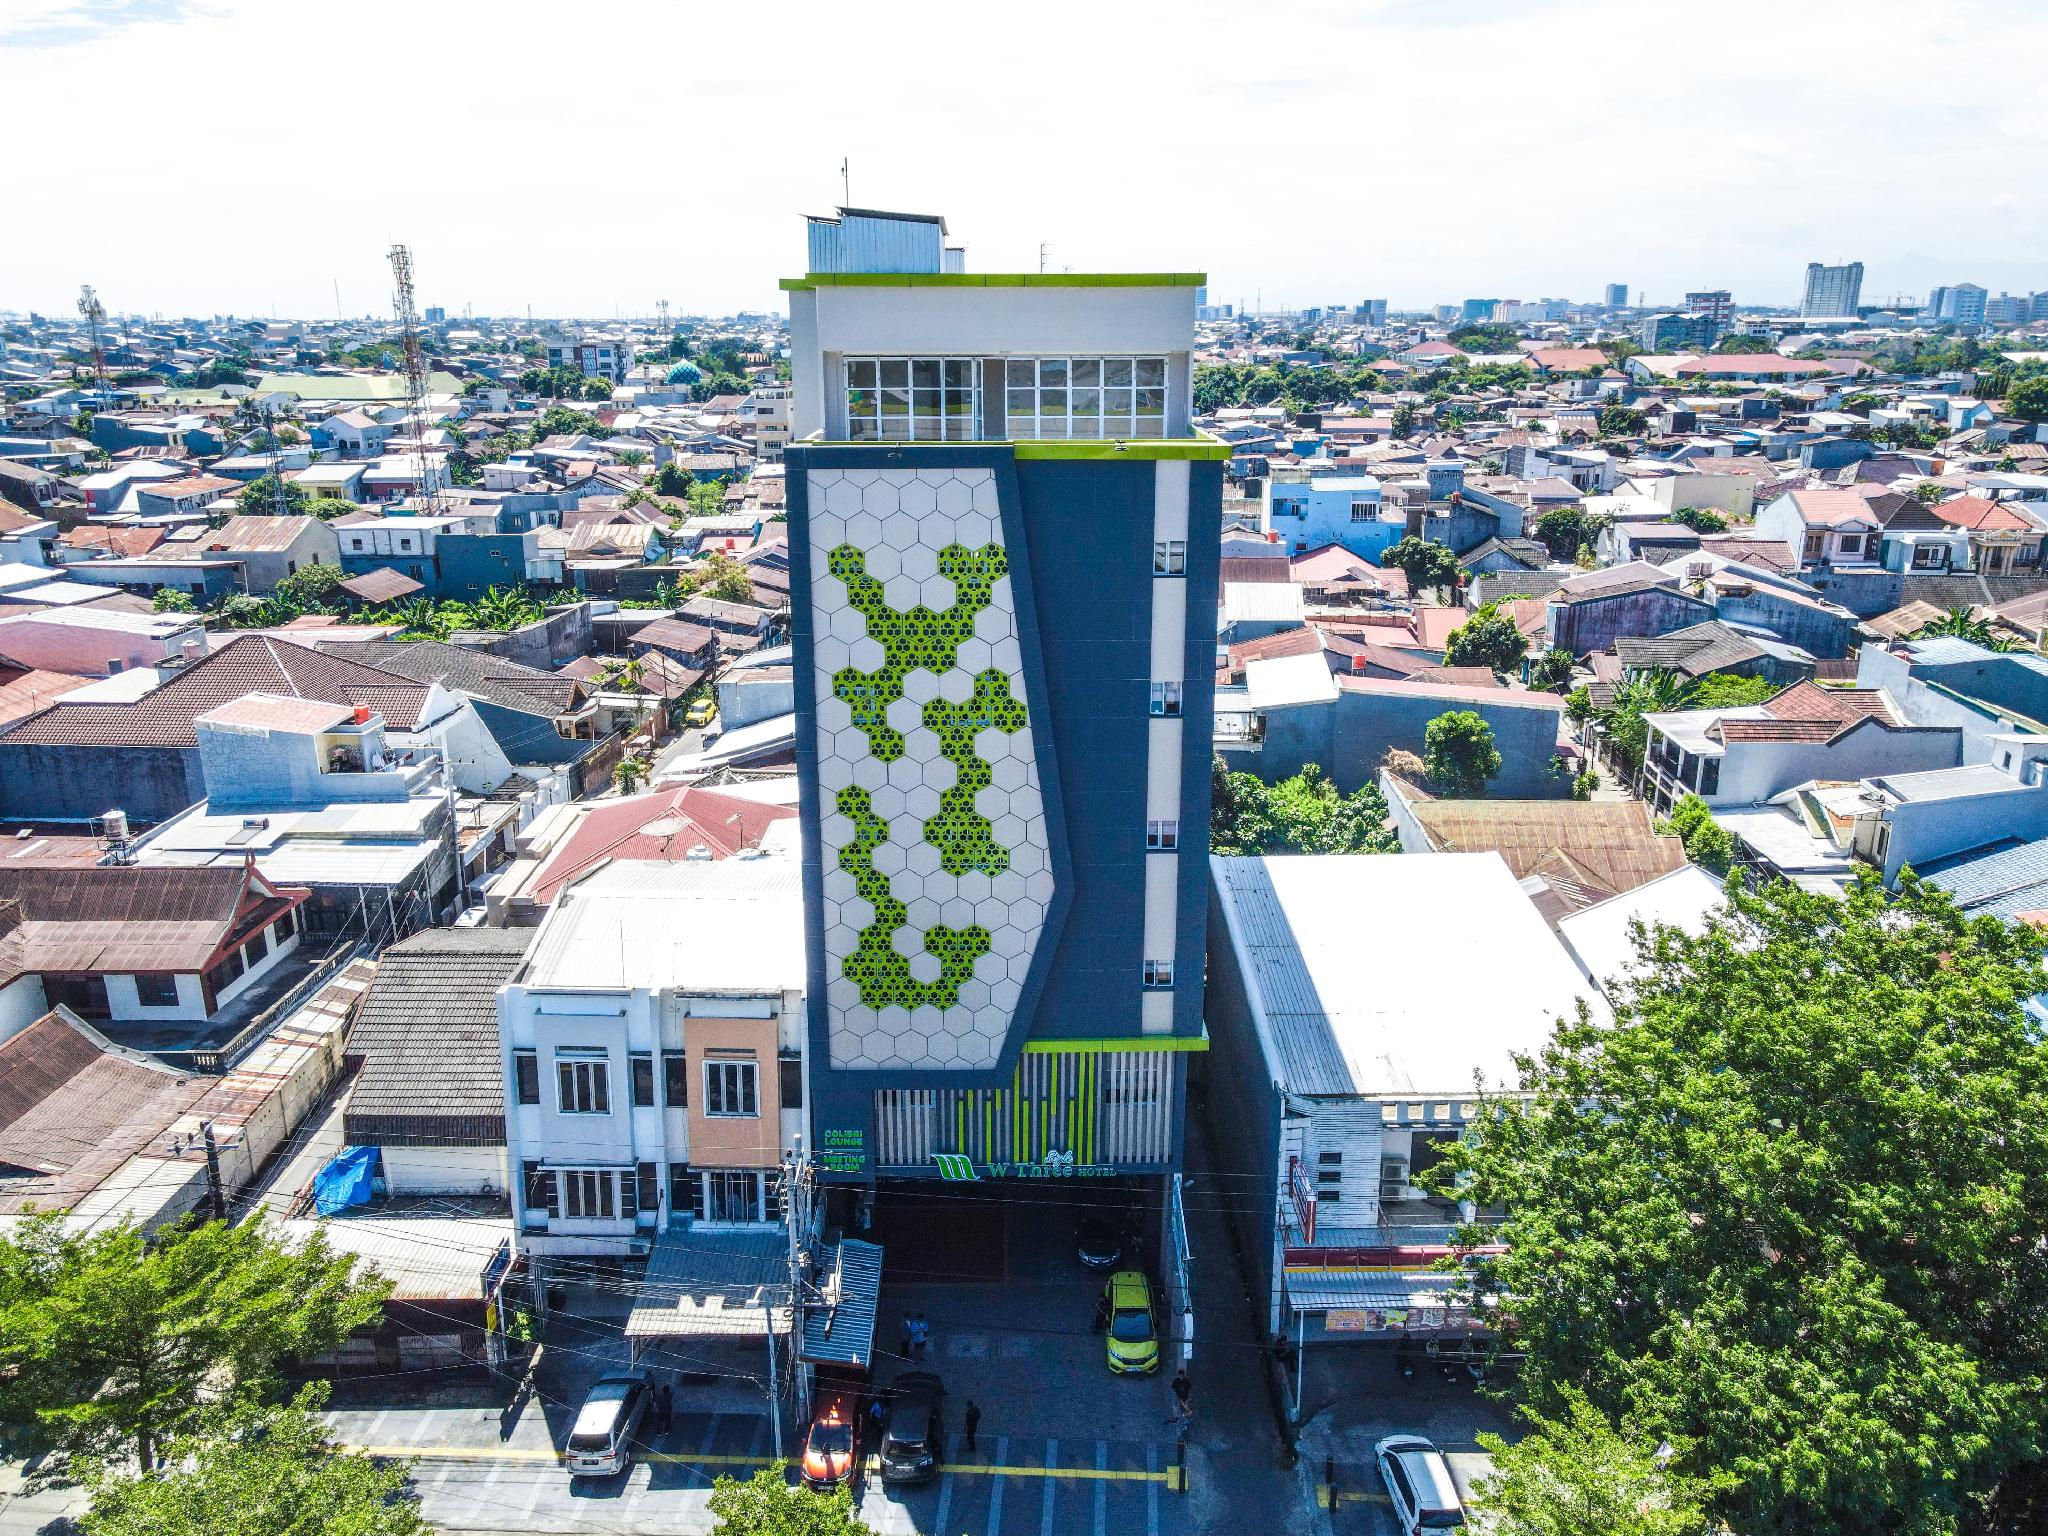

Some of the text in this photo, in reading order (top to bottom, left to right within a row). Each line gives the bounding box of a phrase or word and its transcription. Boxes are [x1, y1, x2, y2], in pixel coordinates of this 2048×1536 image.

[824, 1137, 863, 1146] LOUNGE
[823, 1155, 866, 1164] MEETING
[830, 1163, 860, 1171] ROOM
[987, 1161, 1117, 1178] W Three HOTEL
